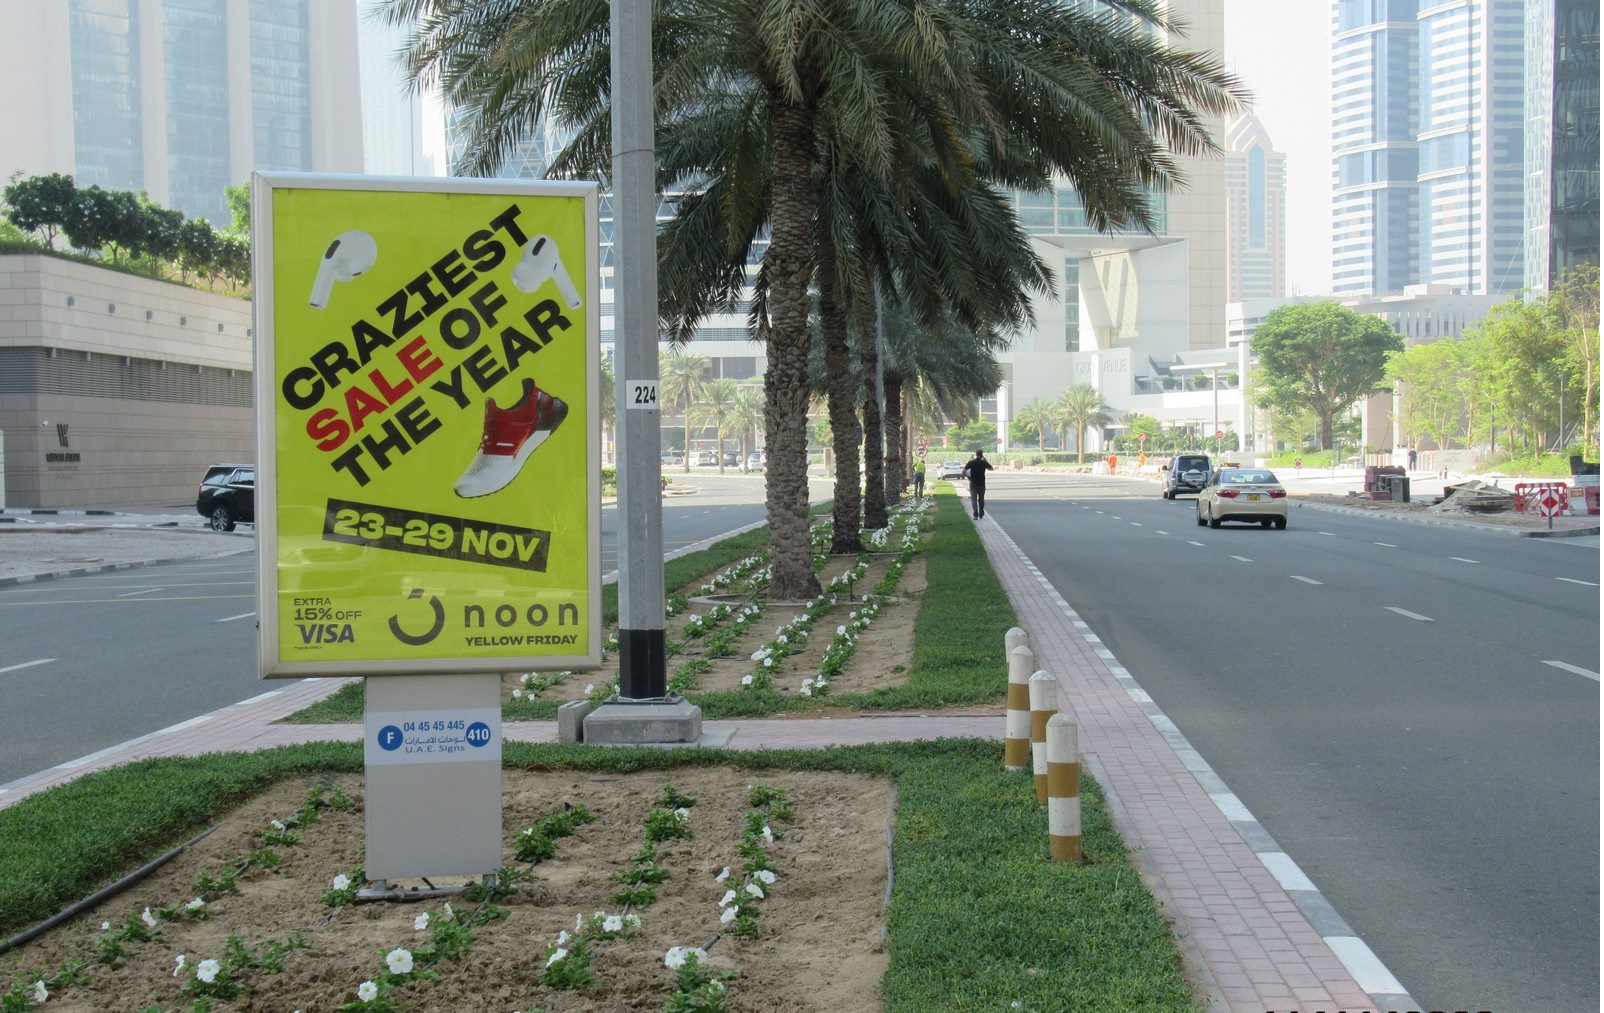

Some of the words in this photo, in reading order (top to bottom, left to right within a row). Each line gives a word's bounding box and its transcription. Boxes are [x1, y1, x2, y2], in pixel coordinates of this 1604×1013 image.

[282, 204, 529, 411] CRAZIEST
[306, 335, 445, 452] SALE
[439, 280, 508, 350] OF
[330, 396, 443, 487] THE
[430, 298, 573, 410] YEAR
[635, 386, 656, 403] 224
[461, 530, 540, 562] NOV
[294, 597, 332, 606] EXTRA
[294, 608, 333, 620] 15%
[335, 610, 362, 620] OFF
[464, 602, 579, 628] noon
[294, 623, 355, 643] VISA
[465, 636, 524, 646] YELLOW
[526, 634, 579, 645] FRIDAY
[403, 722, 416, 732] 04
[418, 721, 430, 731] 45
[432, 721, 445, 731] 45
[447, 720, 465, 730] 445
[387, 732, 395, 744] F
[467, 728, 489, 741] 410
[405, 745, 436, 753] U.A.E.
[439, 744, 465, 753] Signs
